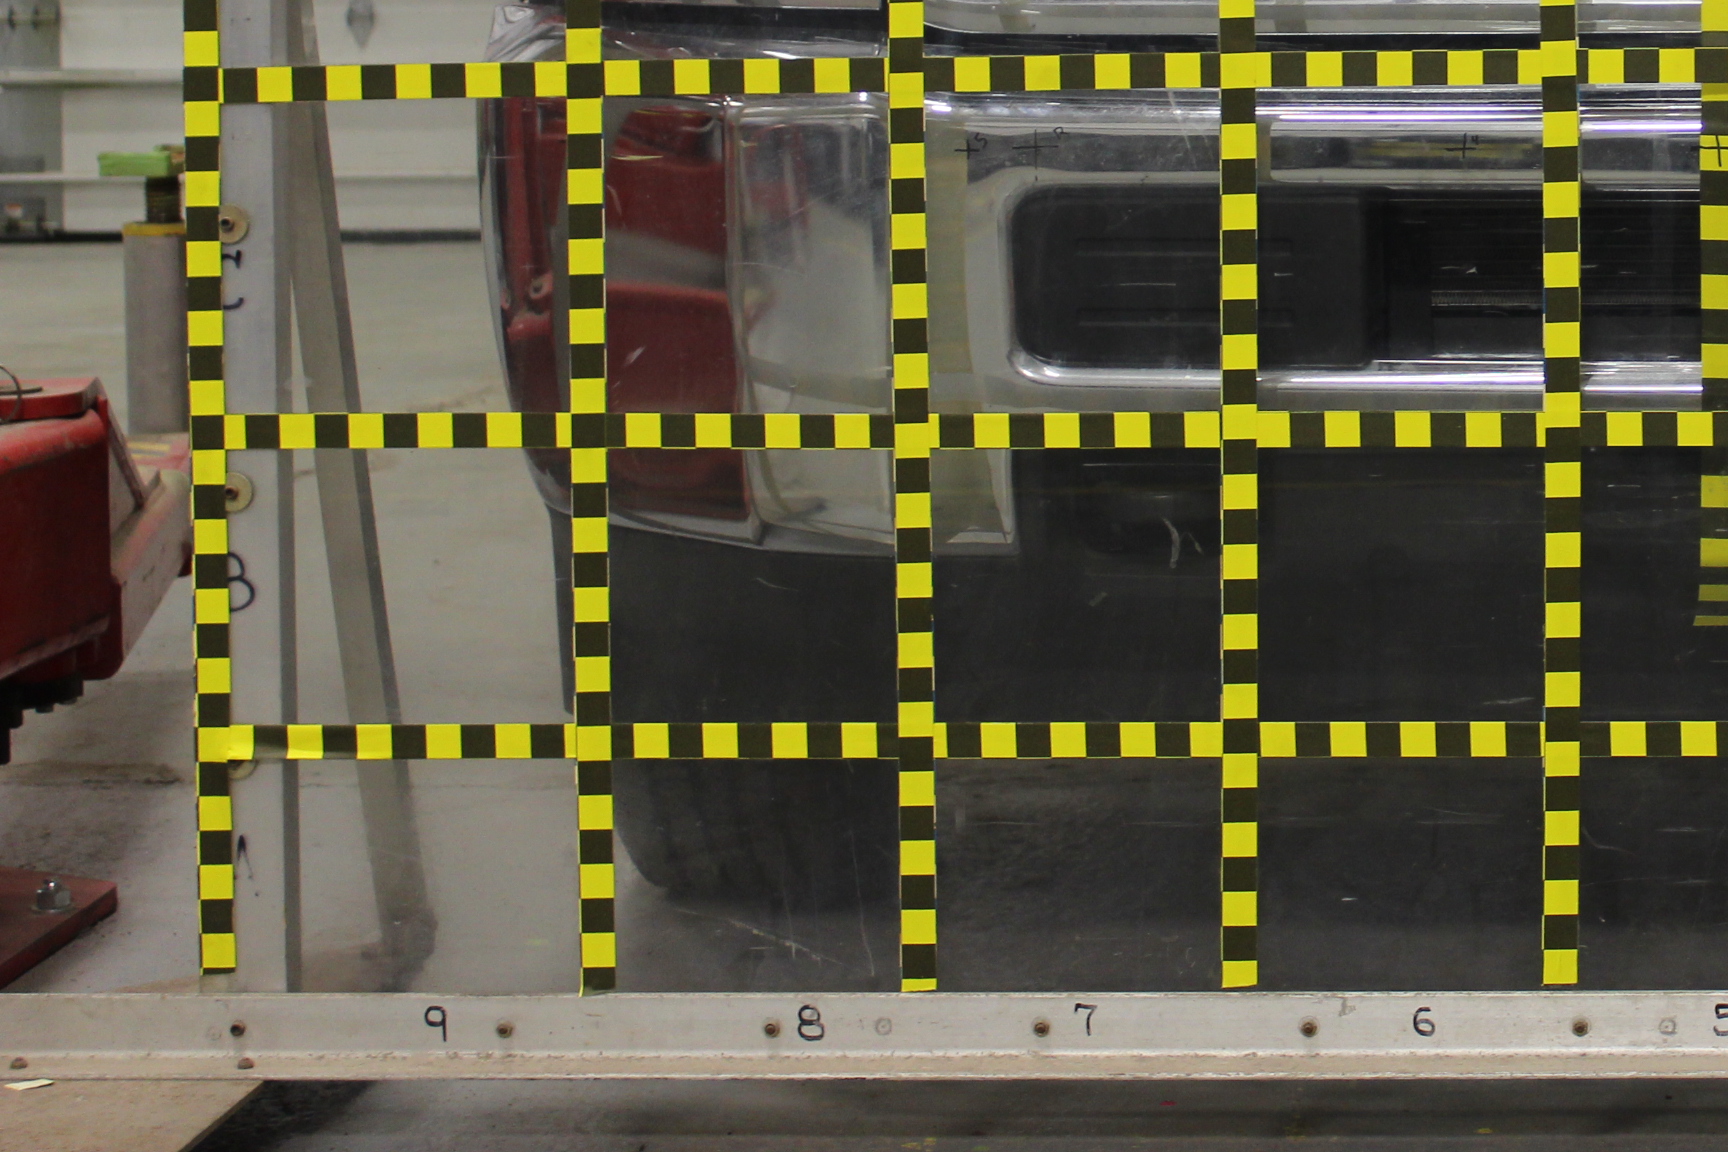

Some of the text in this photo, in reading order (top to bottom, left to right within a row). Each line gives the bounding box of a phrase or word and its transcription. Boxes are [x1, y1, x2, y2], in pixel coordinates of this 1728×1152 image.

[423, 1004, 448, 1043] 9
[797, 1003, 826, 1043] 8
[1073, 1002, 1097, 1038] 7
[1411, 1006, 1437, 1038] 6
